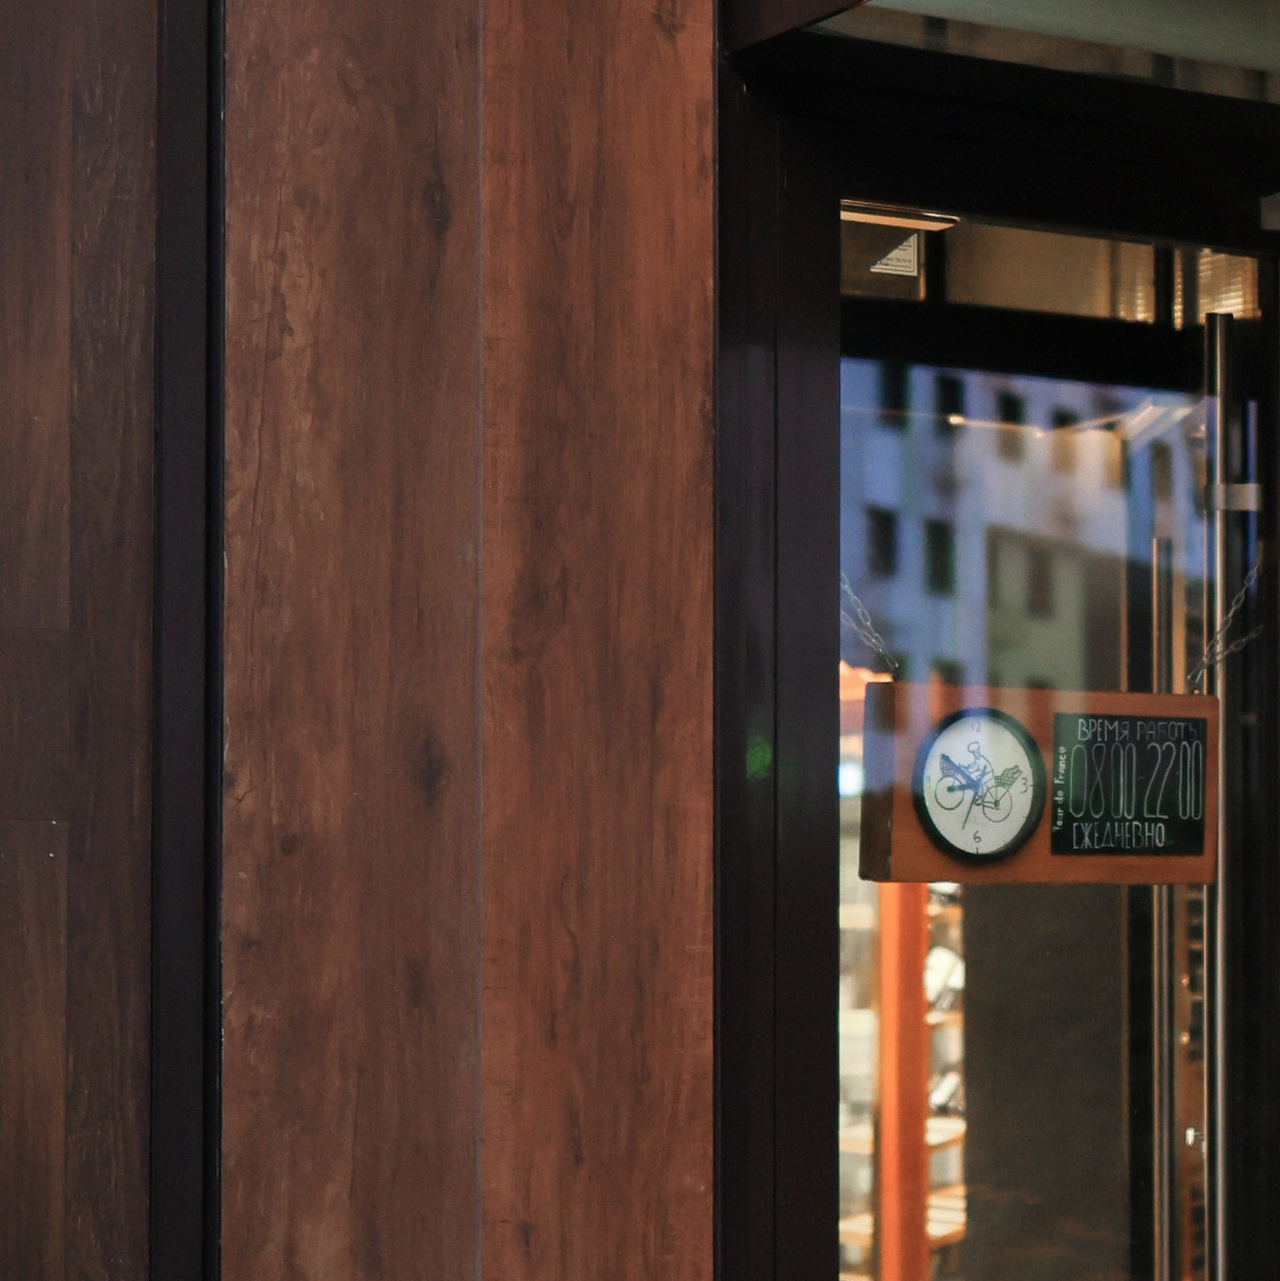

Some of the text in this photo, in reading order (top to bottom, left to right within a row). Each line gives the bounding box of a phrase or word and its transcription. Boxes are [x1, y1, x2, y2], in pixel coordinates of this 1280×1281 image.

[971, 721, 981, 733] 12
[1077, 719, 1130, 741] ВРЕМЯ
[1020, 777, 1029, 794] 3
[1052, 746, 1067, 832] Tour de France
[973, 830, 982, 843] 6
[1072, 821, 1166, 849] ЕЖЕДНЕВНО
